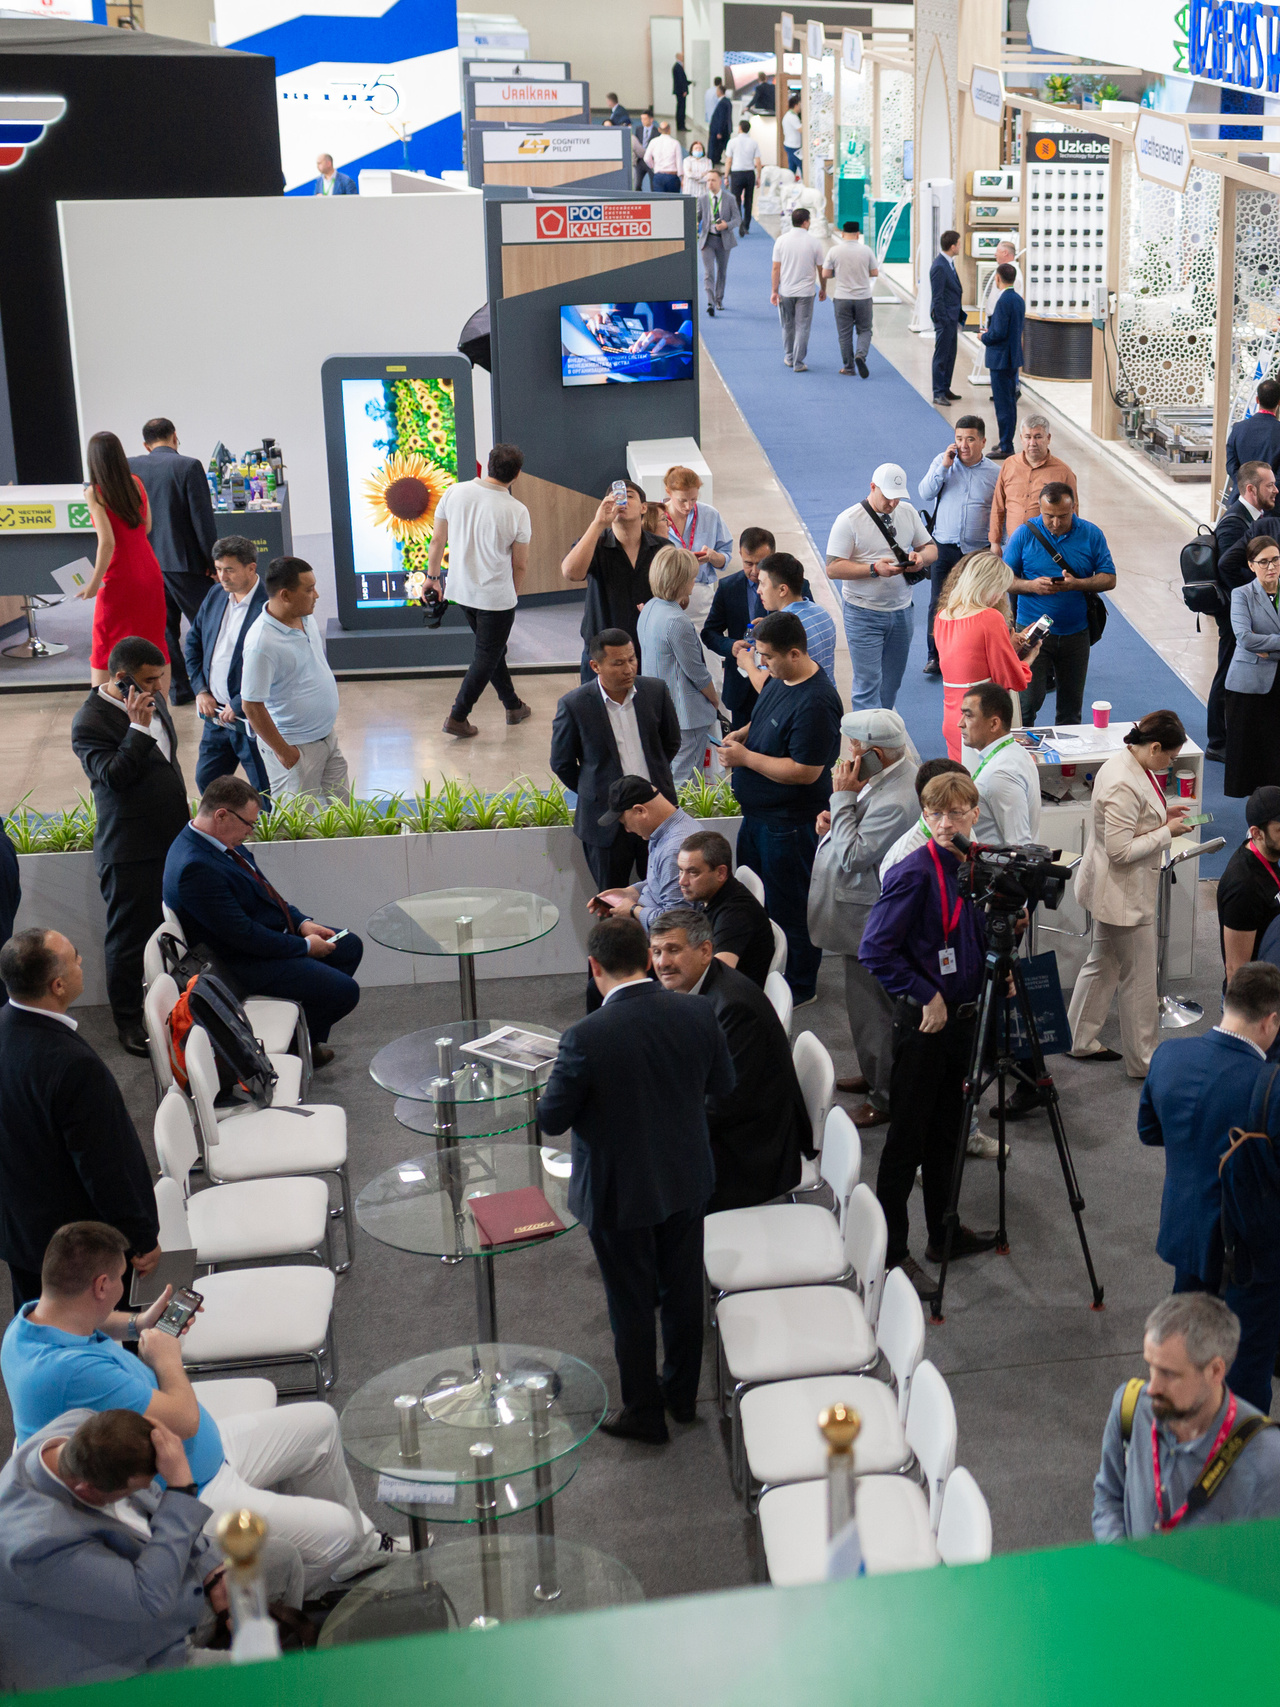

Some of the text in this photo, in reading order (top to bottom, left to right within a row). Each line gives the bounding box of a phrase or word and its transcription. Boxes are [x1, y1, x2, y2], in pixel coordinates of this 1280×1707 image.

[1058, 139, 1110, 154] Uzkabe
[569, 206, 602, 220] РОС
[570, 222, 651, 236] КАЧЕСТВО
[19, 516, 52, 524] ЗНАК
